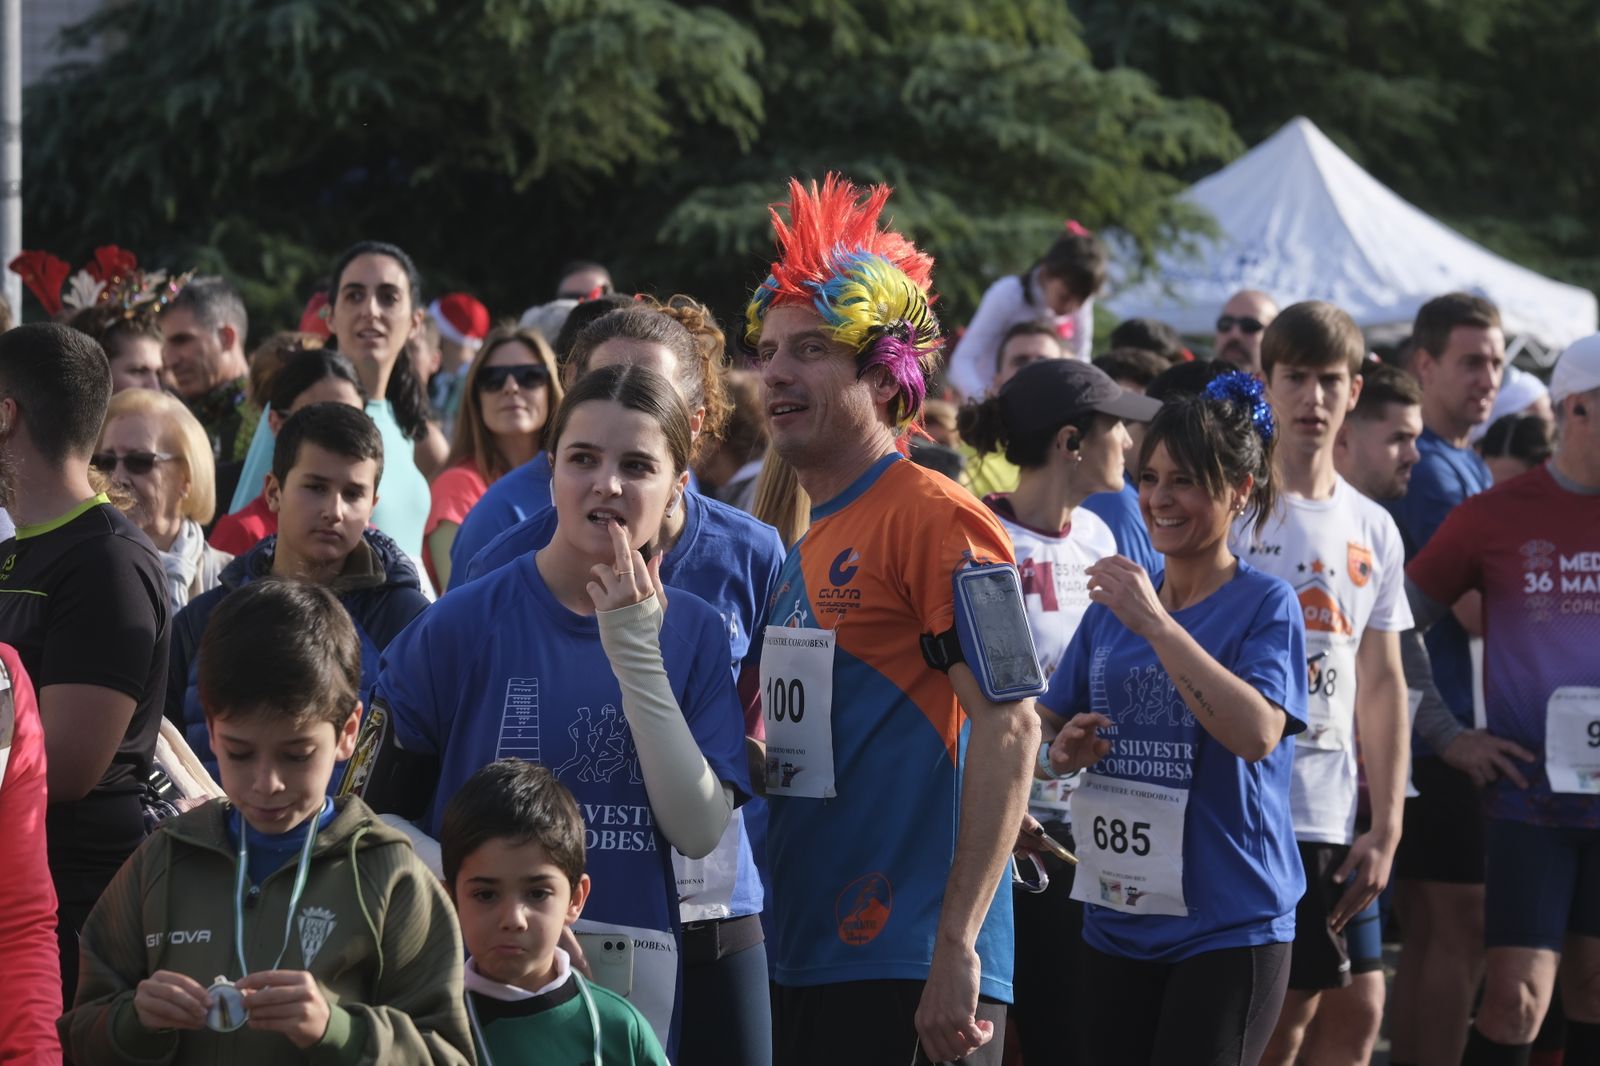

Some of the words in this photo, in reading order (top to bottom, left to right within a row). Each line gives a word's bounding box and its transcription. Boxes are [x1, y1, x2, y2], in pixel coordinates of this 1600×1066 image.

[1523, 571, 1554, 593] 36
[1561, 575, 1600, 593] MA
[766, 676, 805, 724] 100
[1120, 740, 1195, 759] SILVESTR
[1094, 758, 1193, 780] CORDOBESA
[1130, 788, 1180, 803] CORDOBESA
[1093, 815, 1151, 857] 685
[676, 878, 705, 886] ARDENAS
